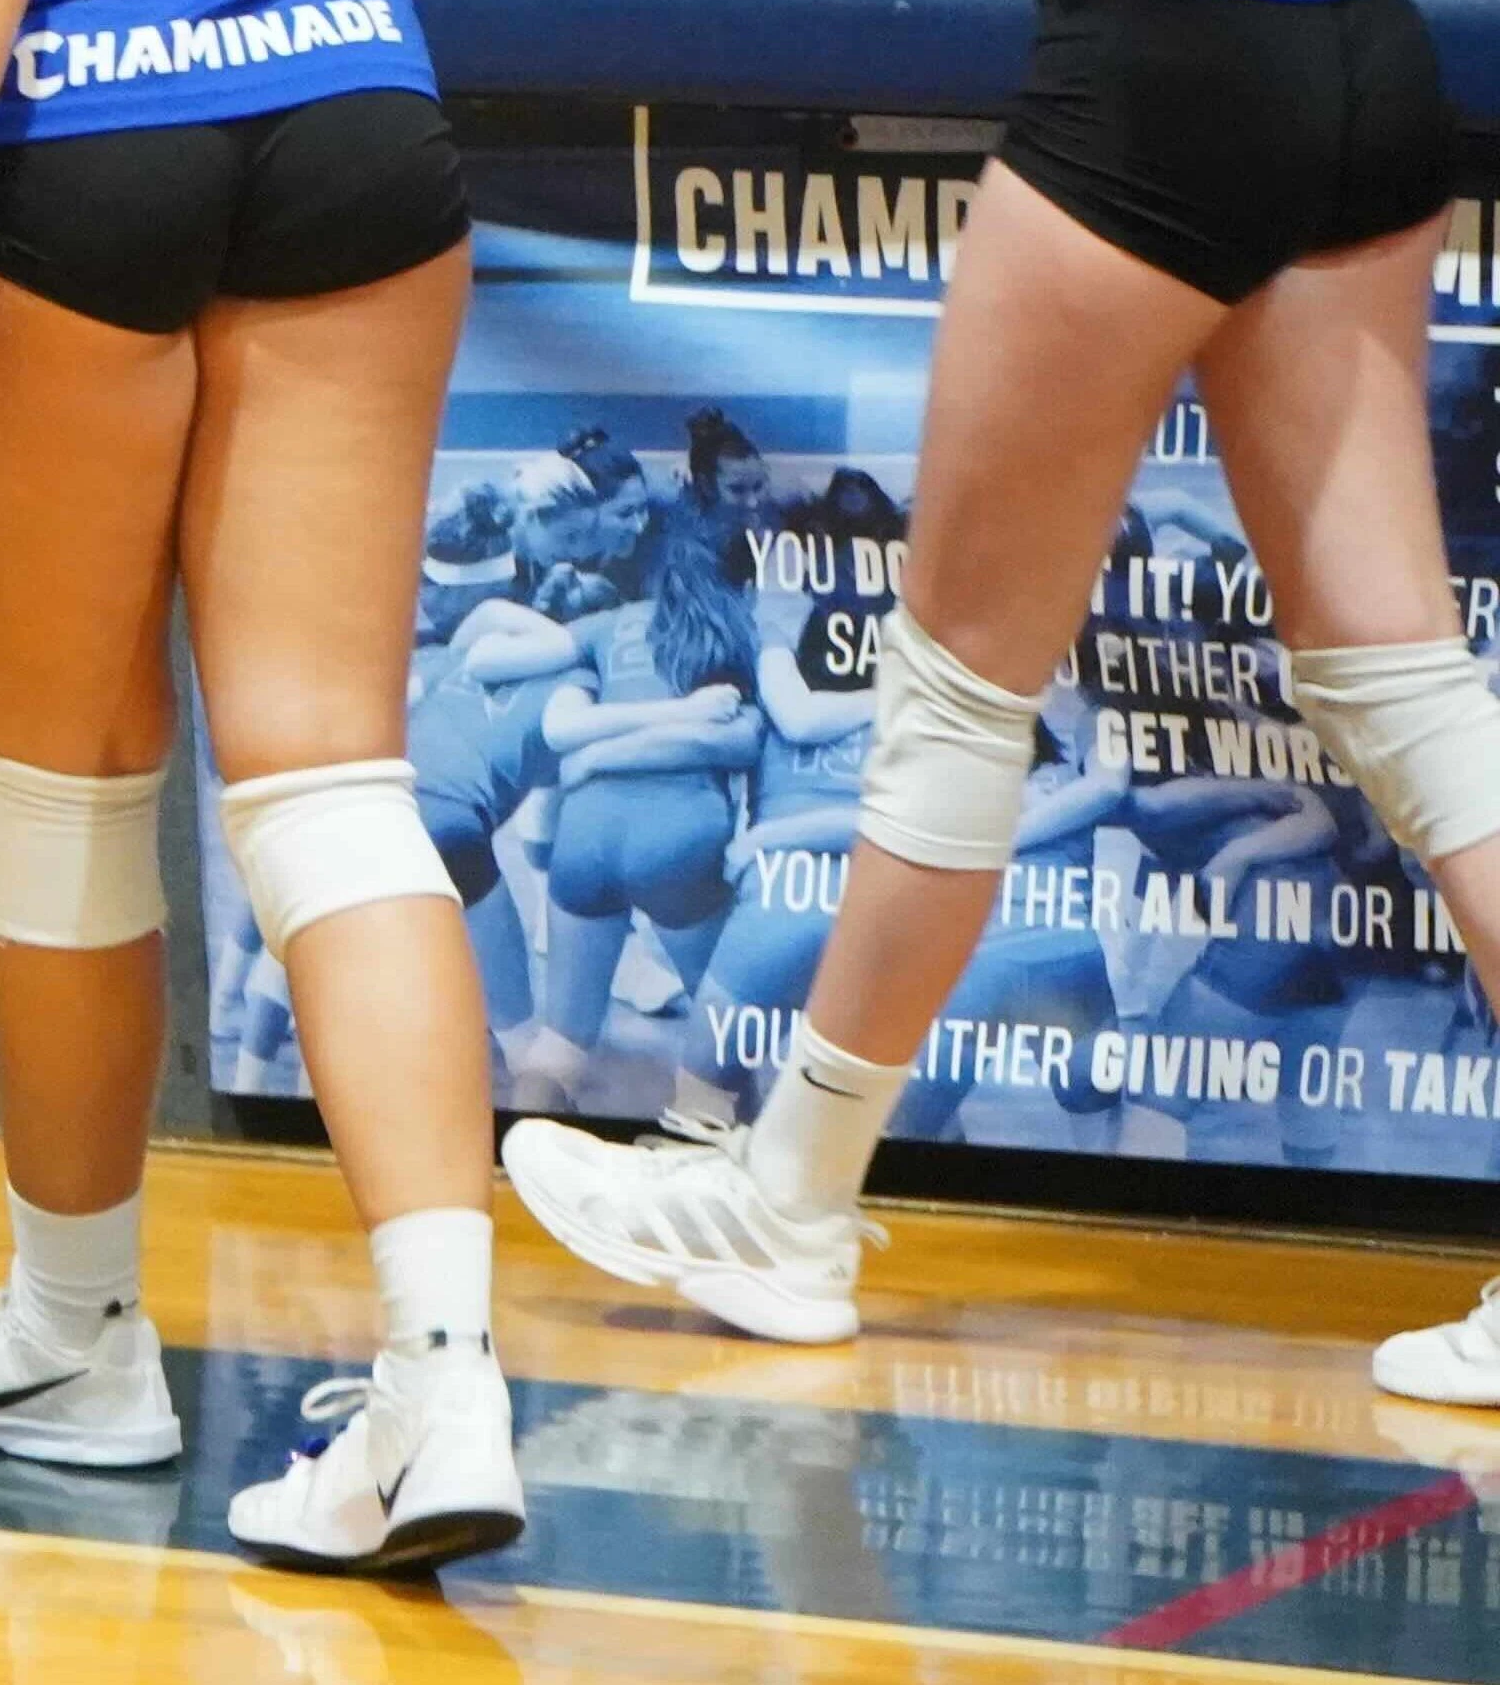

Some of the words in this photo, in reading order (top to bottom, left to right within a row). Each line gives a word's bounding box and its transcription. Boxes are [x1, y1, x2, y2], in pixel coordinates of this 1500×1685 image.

[674, 167, 978, 283] CHAMP
[746, 528, 836, 594] YOU
[1128, 555, 1196, 621] IT!
[1214, 561, 1275, 628] YO
[1096, 632, 1260, 706] EITHER
[1096, 709, 1190, 775] GET
[755, 848, 849, 914] YOU
[1002, 864, 1122, 931] THER
[1139, 872, 1238, 939] ALL
[1256, 879, 1312, 944] IN
[1330, 883, 1393, 950] OR
[911, 1017, 1073, 1088] ITHER
[1090, 1030, 1281, 1104] GIVING
[1301, 1044, 1365, 1110] OR
